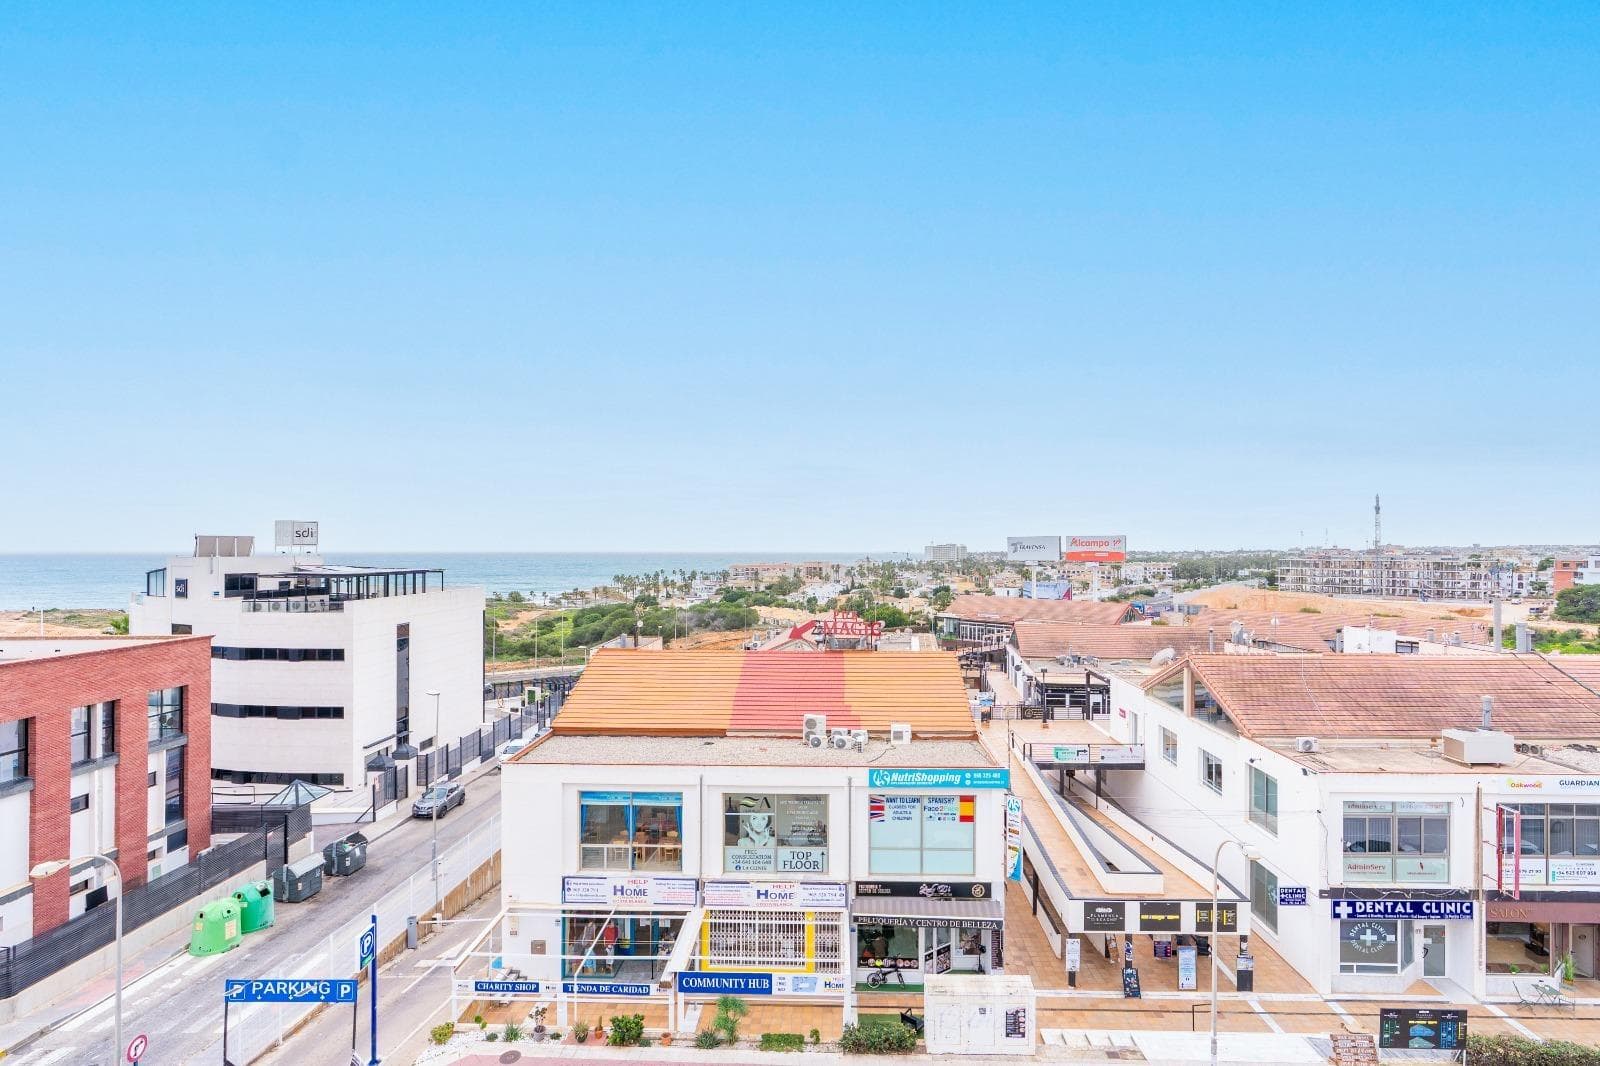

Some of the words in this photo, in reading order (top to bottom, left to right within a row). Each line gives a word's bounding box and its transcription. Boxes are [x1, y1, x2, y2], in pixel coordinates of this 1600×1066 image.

[295, 528, 314, 538] sdi
[1070, 538, 1110, 548] Alcampo
[890, 772, 962, 785] NutriShopping
[1559, 779, 1600, 787] GUARDIAN
[927, 797, 955, 805] SPANISH?
[790, 851, 812, 860] TOP
[783, 860, 820, 870] FLOOR
[1347, 863, 1386, 871] AdminServ
[613, 885, 649, 897] HOME
[756, 889, 795, 900] HOME
[1355, 901, 1414, 914] DENTAL
[1422, 901, 1471, 914] CLINIC
[915, 919, 948, 928] CENTRO
[949, 920, 961, 929] DE
[962, 920, 998, 930] BELLEZA
[1349, 922, 1369, 937] DENTAL
[1371, 922, 1388, 937] CLINIC
[363, 934, 372, 954] P
[1349, 939, 1369, 954] DENTAL
[477, 982, 513, 991] CHARITY
[514, 983, 537, 991] SHOP
[682, 977, 746, 989] COMMUNITY
[748, 978, 770, 989] HUB
[251, 981, 331, 995] PARKING
[340, 984, 351, 998] P
[567, 984, 598, 993] TENDA
[599, 984, 611, 993] DE
[611, 985, 649, 994] CARIDAD
